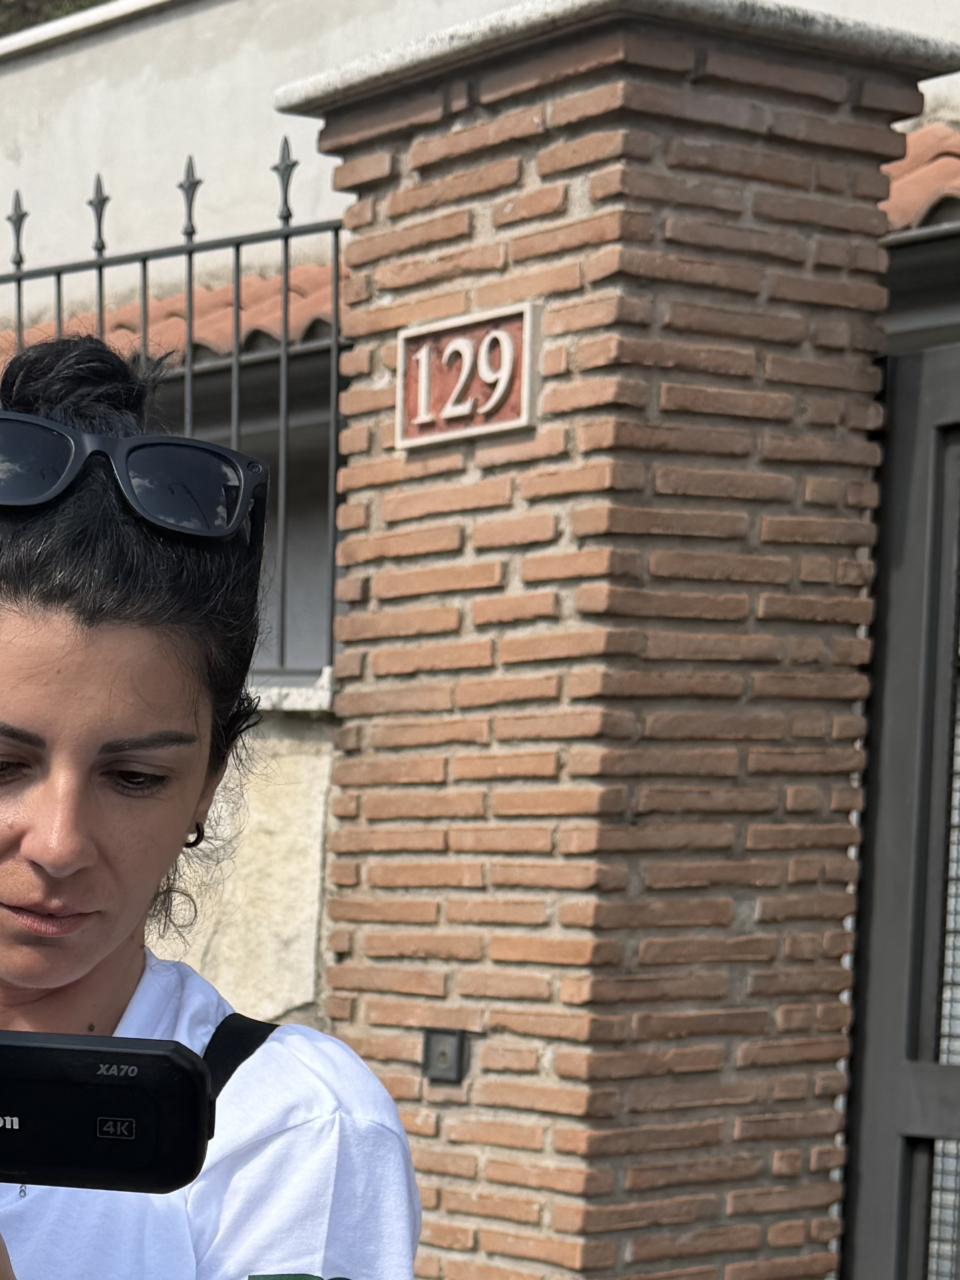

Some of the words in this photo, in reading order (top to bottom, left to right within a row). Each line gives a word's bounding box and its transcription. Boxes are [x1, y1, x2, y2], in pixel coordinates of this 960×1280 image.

[411, 329, 515, 425] 129
[96, 1063, 139, 1078] XA70
[102, 1120, 130, 1136] 4K
